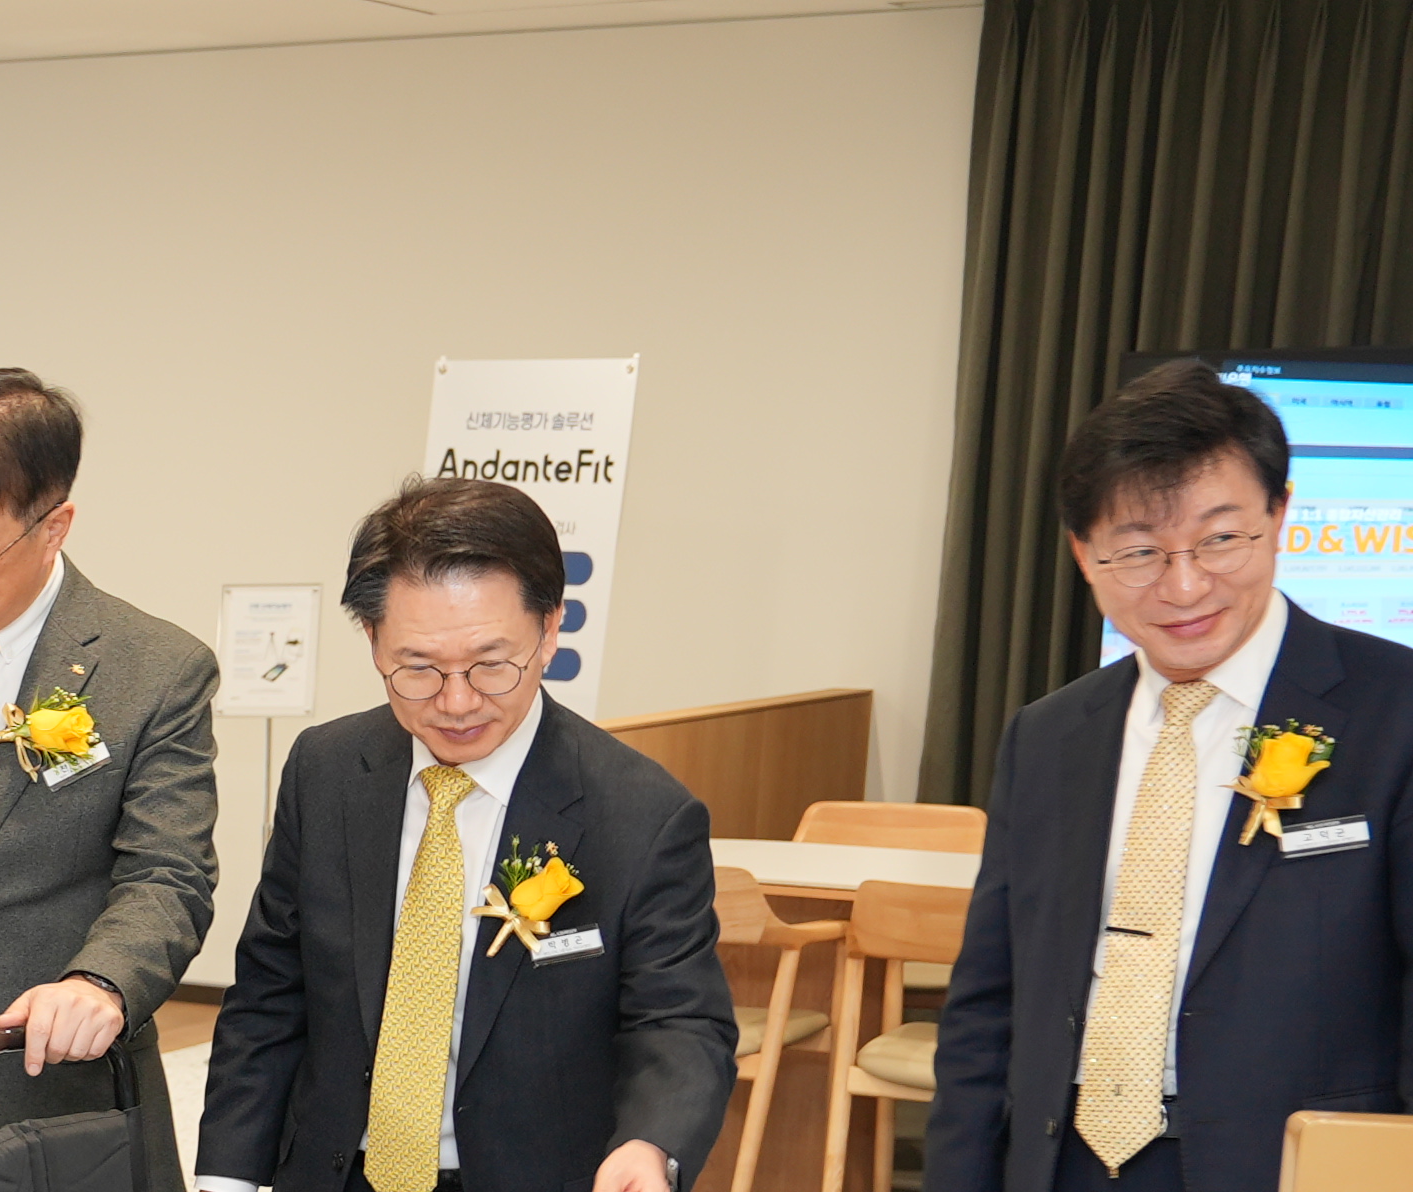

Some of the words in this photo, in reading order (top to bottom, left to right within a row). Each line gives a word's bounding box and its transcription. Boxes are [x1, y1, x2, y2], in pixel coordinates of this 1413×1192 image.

[466, 411, 549, 431] 신체기능평가
[551, 412, 594, 431] 솔루션
[438, 448, 615, 484] AndanteFit
[1317, 524, 1344, 553] &
